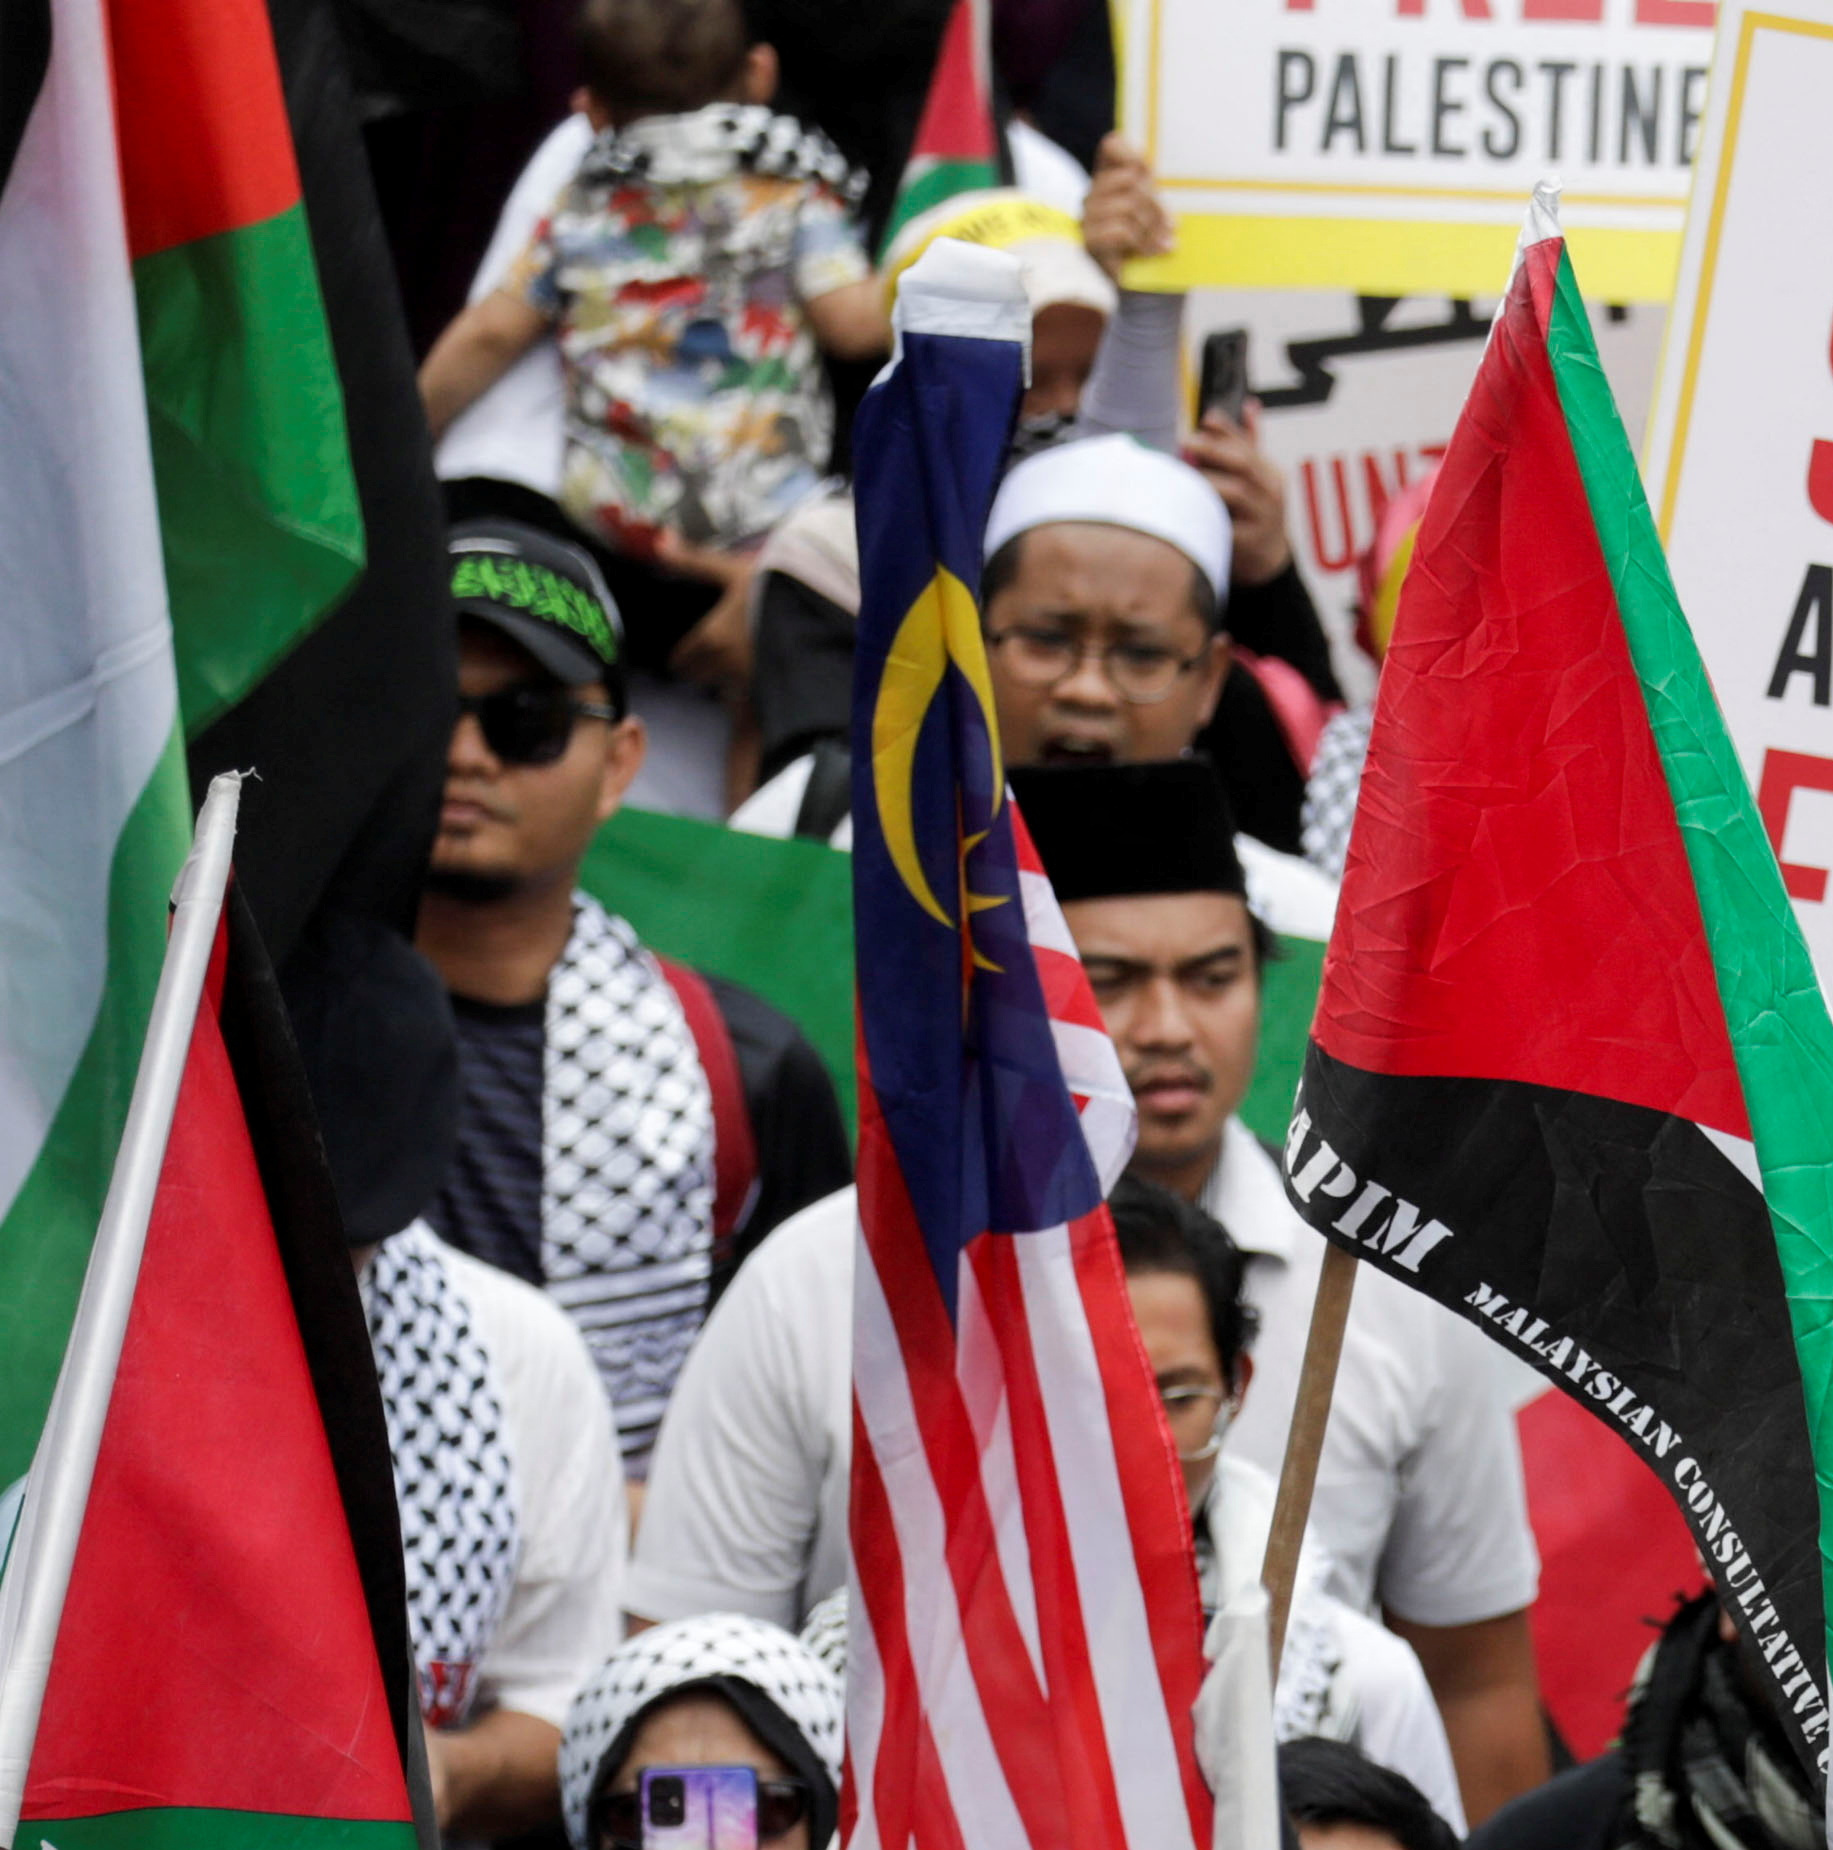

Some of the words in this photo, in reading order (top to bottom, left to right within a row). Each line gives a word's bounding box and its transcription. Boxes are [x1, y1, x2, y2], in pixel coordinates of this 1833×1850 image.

[1274, 50, 1708, 168] PALESTINE
[1283, 1080, 1454, 1275] APIM
[1464, 1281, 1682, 1461] MALAYSIAN
[1673, 1456, 1831, 1746] CONSULTATIVE
